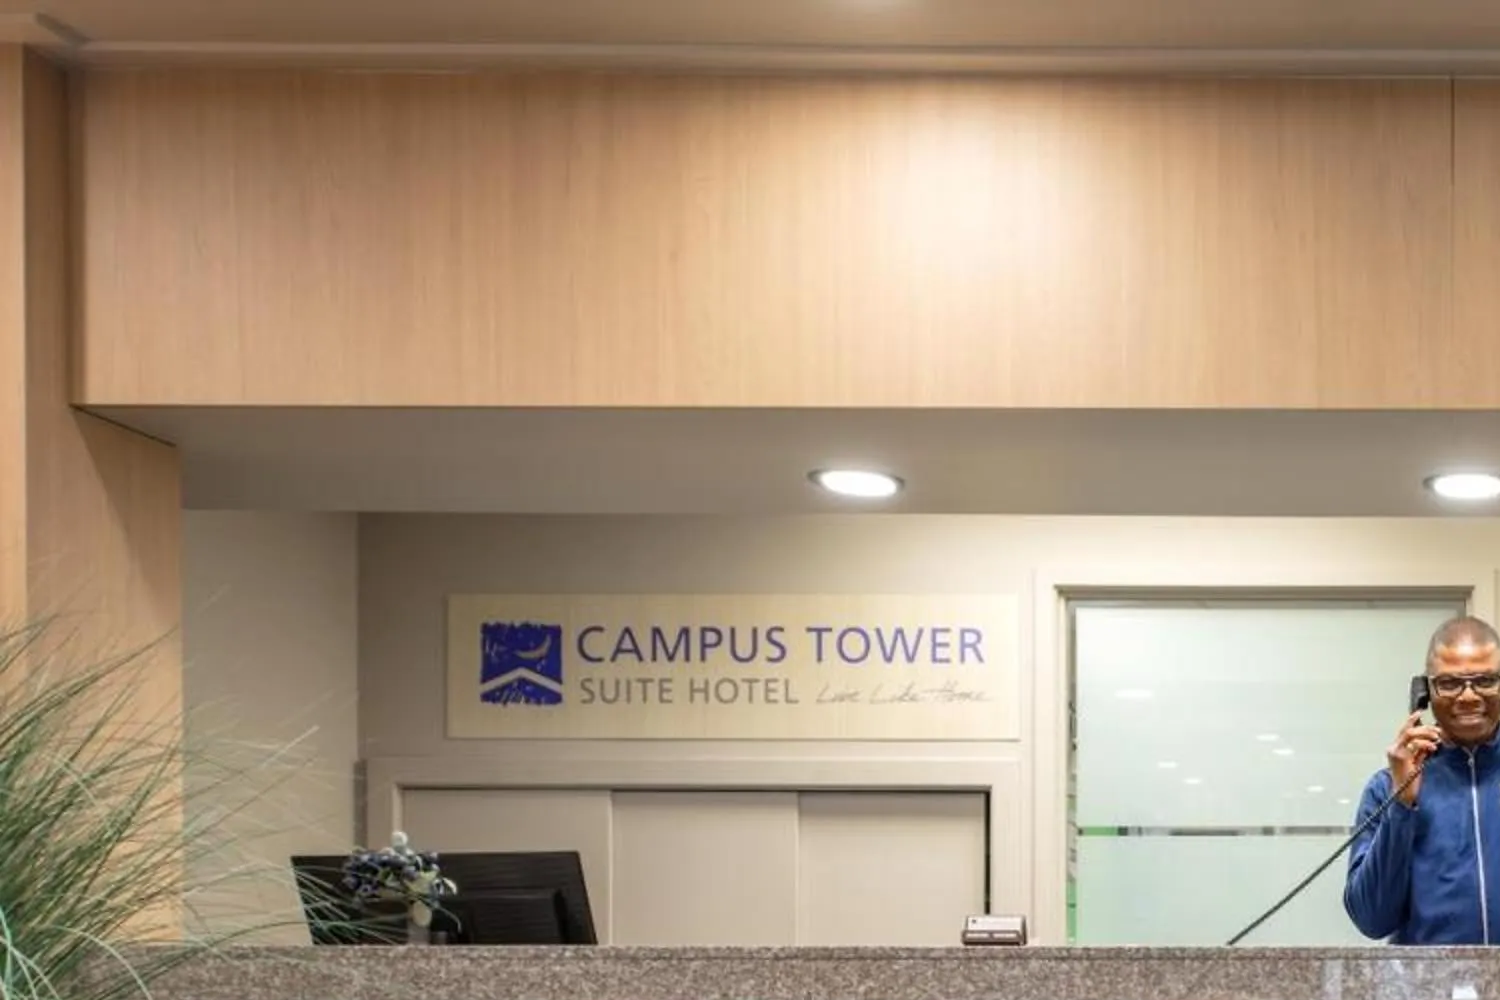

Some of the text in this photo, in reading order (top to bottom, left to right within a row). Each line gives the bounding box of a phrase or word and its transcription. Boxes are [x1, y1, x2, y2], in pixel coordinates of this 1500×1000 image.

[576, 626, 985, 664] CAMPUS TOWER
[579, 677, 674, 705] SUITE
[689, 677, 800, 705] HOTEL
